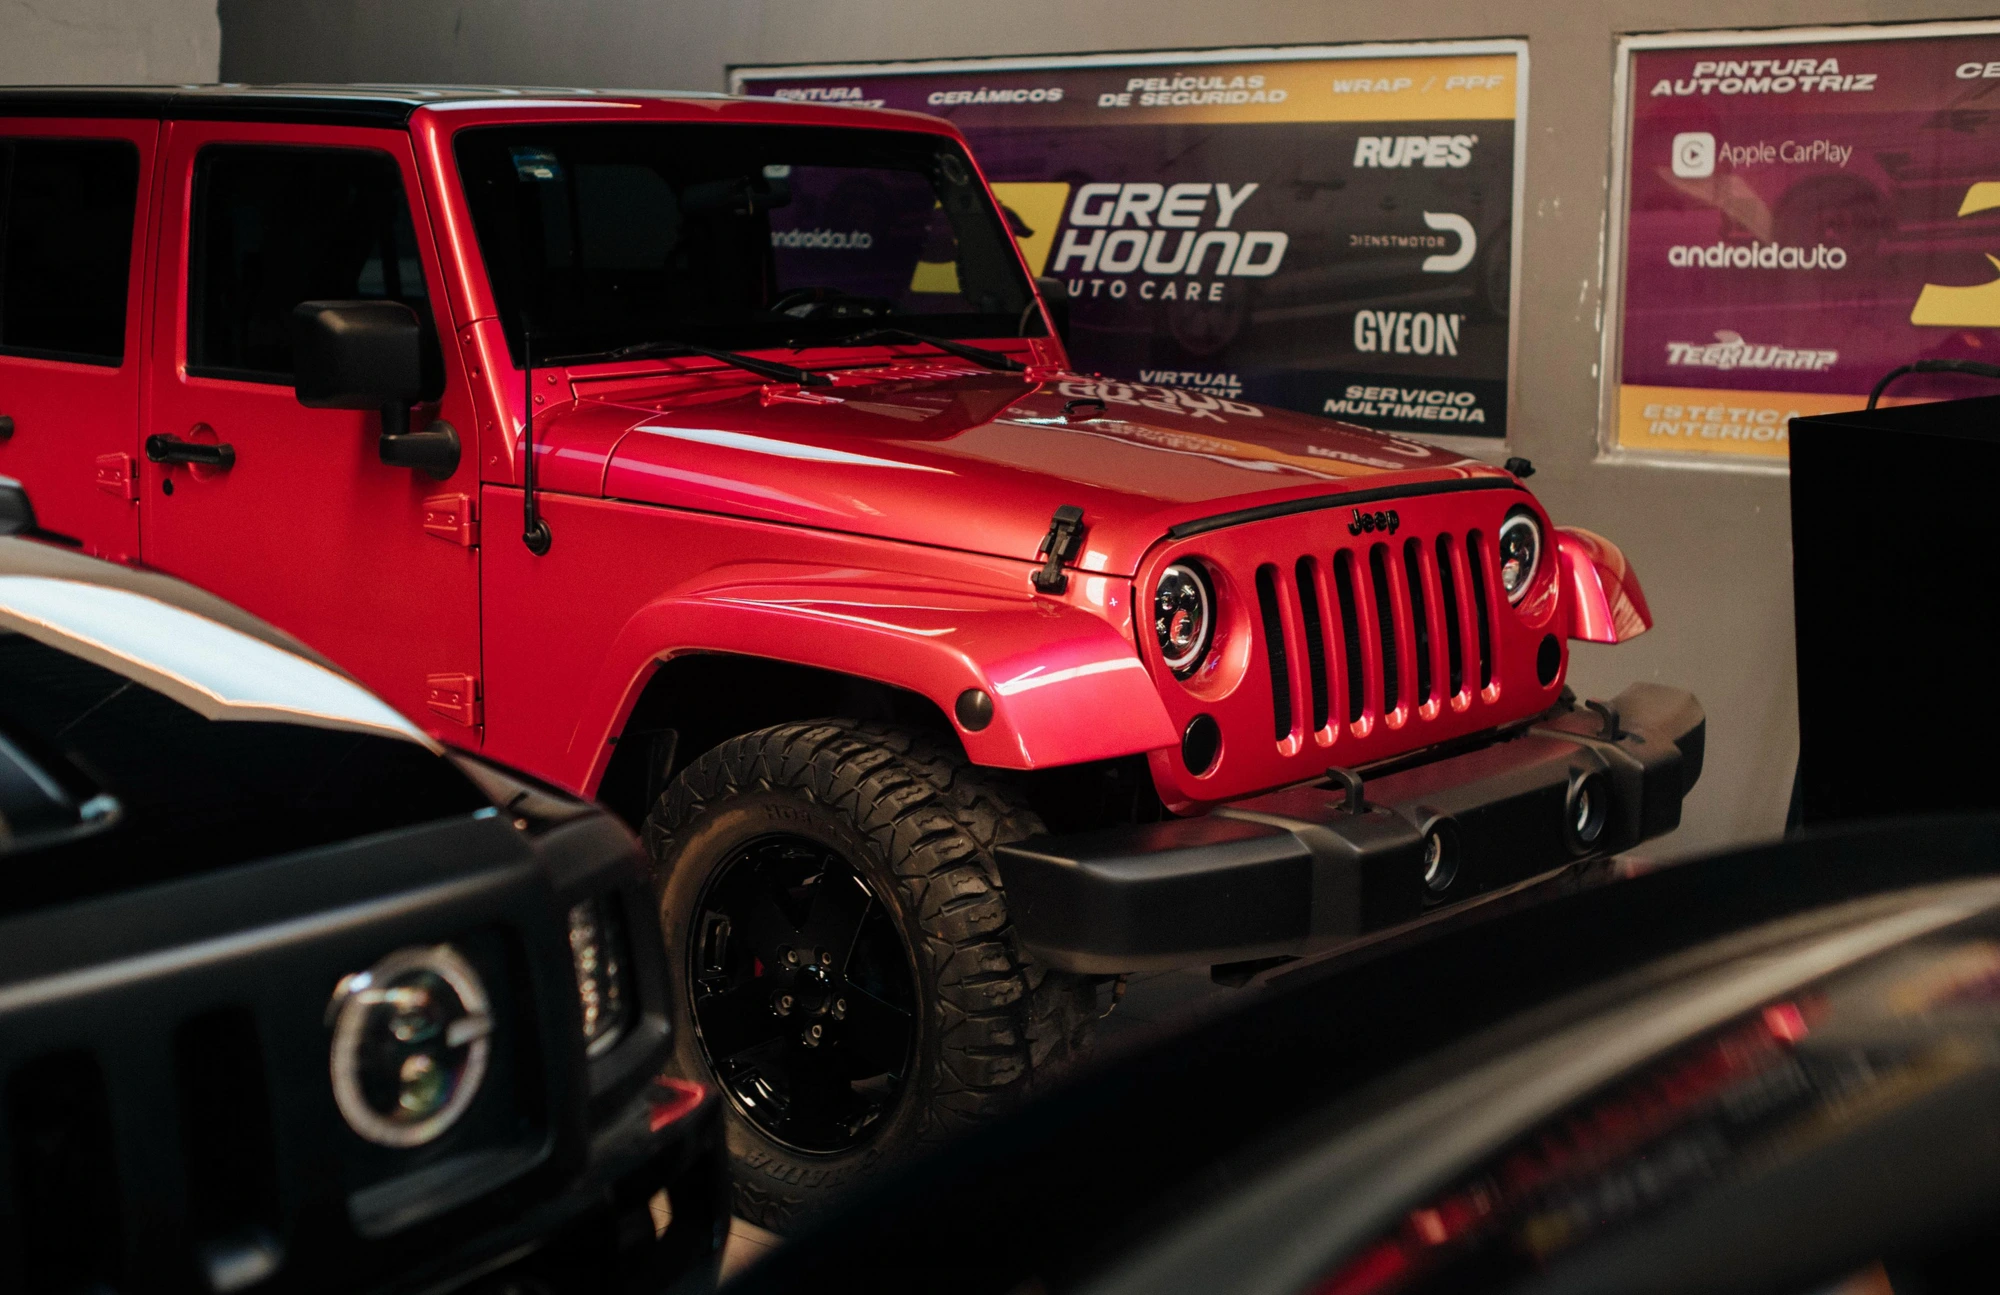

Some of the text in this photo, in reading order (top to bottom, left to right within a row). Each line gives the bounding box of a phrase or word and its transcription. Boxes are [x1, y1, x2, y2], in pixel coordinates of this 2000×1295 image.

[1693, 58, 1839, 78] PINTURA
[1126, 73, 1266, 93] PELÍCULAS
[1332, 76, 1414, 94] WRAP
[1445, 74, 1504, 91] PPF
[1650, 74, 1878, 96] AUTOMOTRIZ
[928, 86, 1064, 106] CERÁMICOS
[1098, 88, 1288, 108] DE SEGURIDAD
[1353, 134, 1473, 169] RUPES
[1719, 139, 1853, 168] Apple CarPlay
[1069, 182, 1260, 228] GREY
[1349, 234, 1446, 248] DIENSTMOTOR
[1053, 228, 1289, 278] HOUND
[1668, 240, 1848, 271] androidauto
[1068, 278, 1225, 302] UTO CARE
[1353, 309, 1460, 356] GYEON
[1138, 369, 1243, 388] VIRTUAL
[1345, 384, 1477, 407] SERVICIO
[1323, 398, 1487, 425] MULTIMEDIA
[1347, 508, 1400, 536] Jeep
